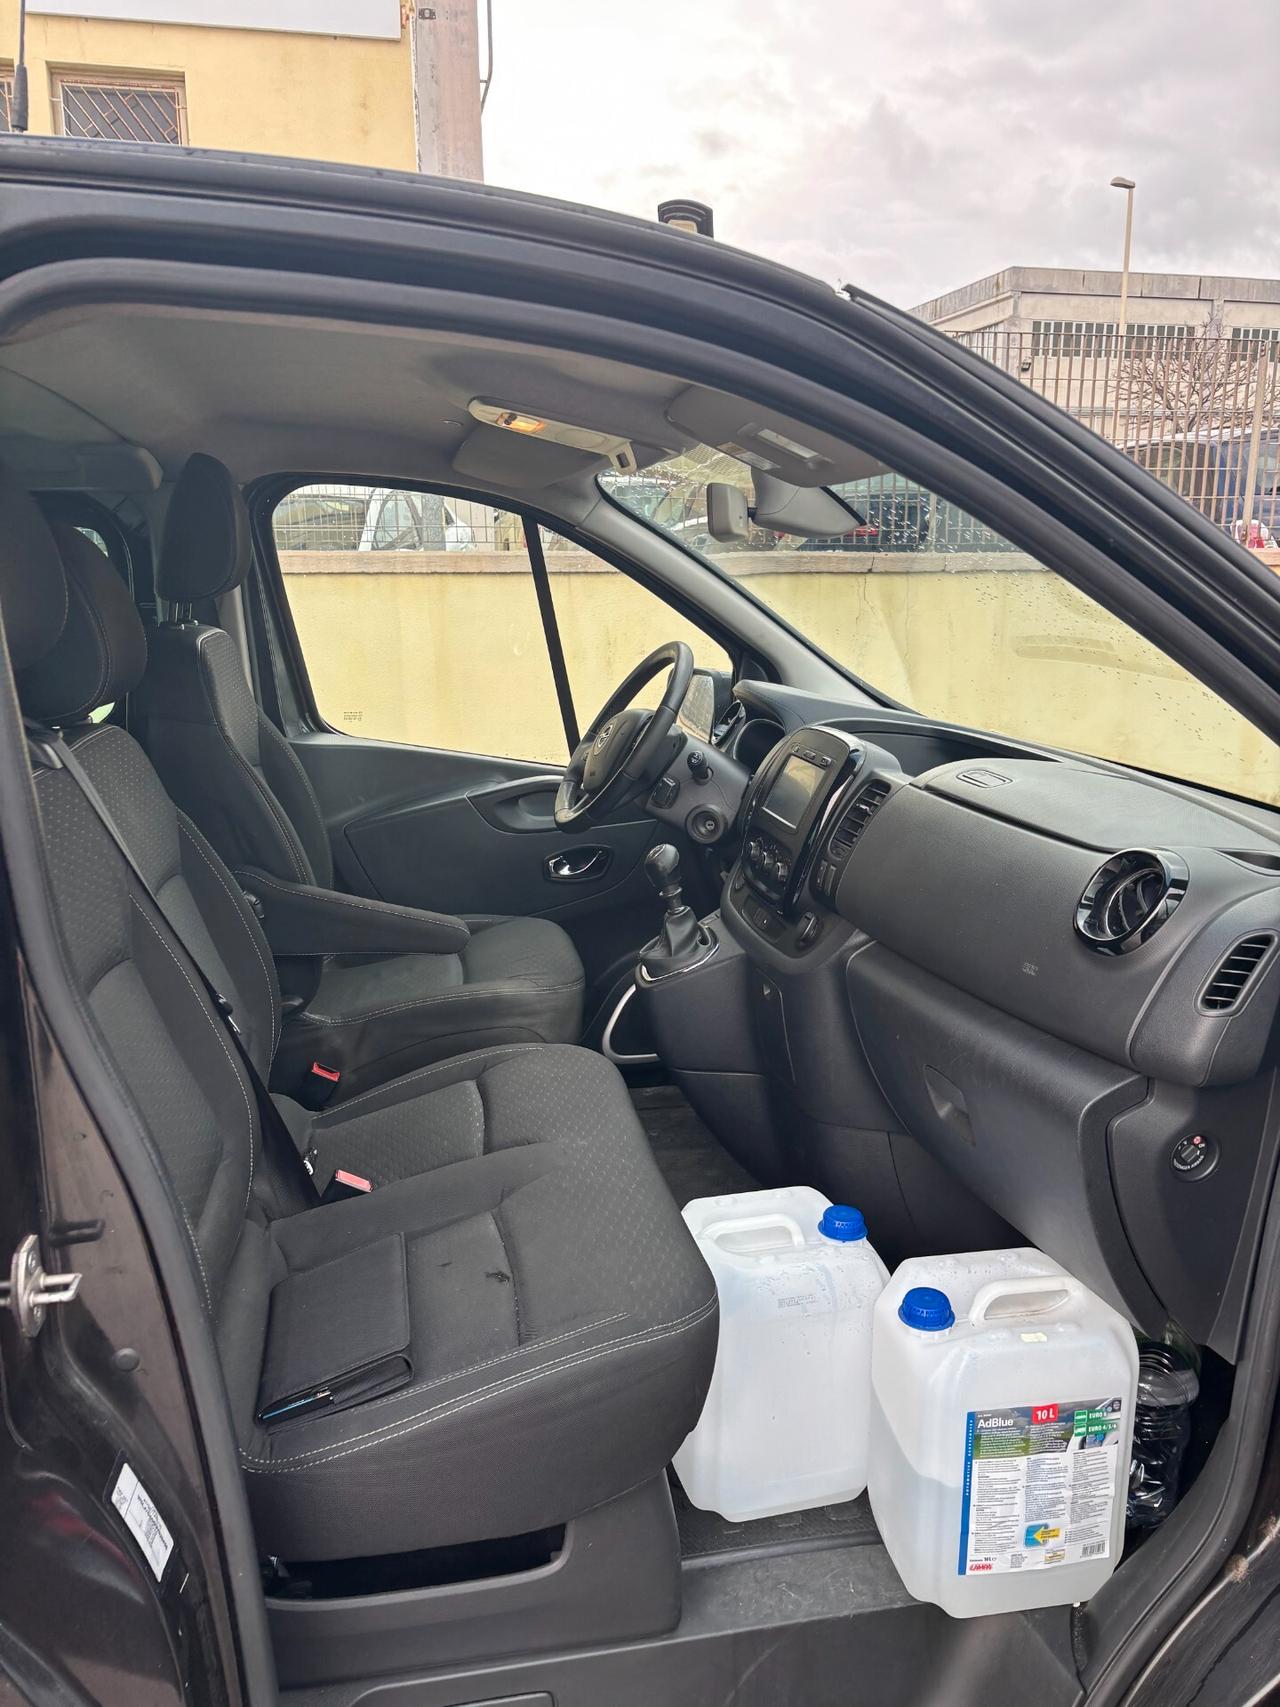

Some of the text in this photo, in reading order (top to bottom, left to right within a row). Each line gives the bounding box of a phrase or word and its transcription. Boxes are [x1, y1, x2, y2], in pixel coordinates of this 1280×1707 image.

[1036, 1407, 1055, 1421] 10 L
[977, 1417, 1014, 1429] AdBlue
[1088, 1425, 1102, 1433] EURO
